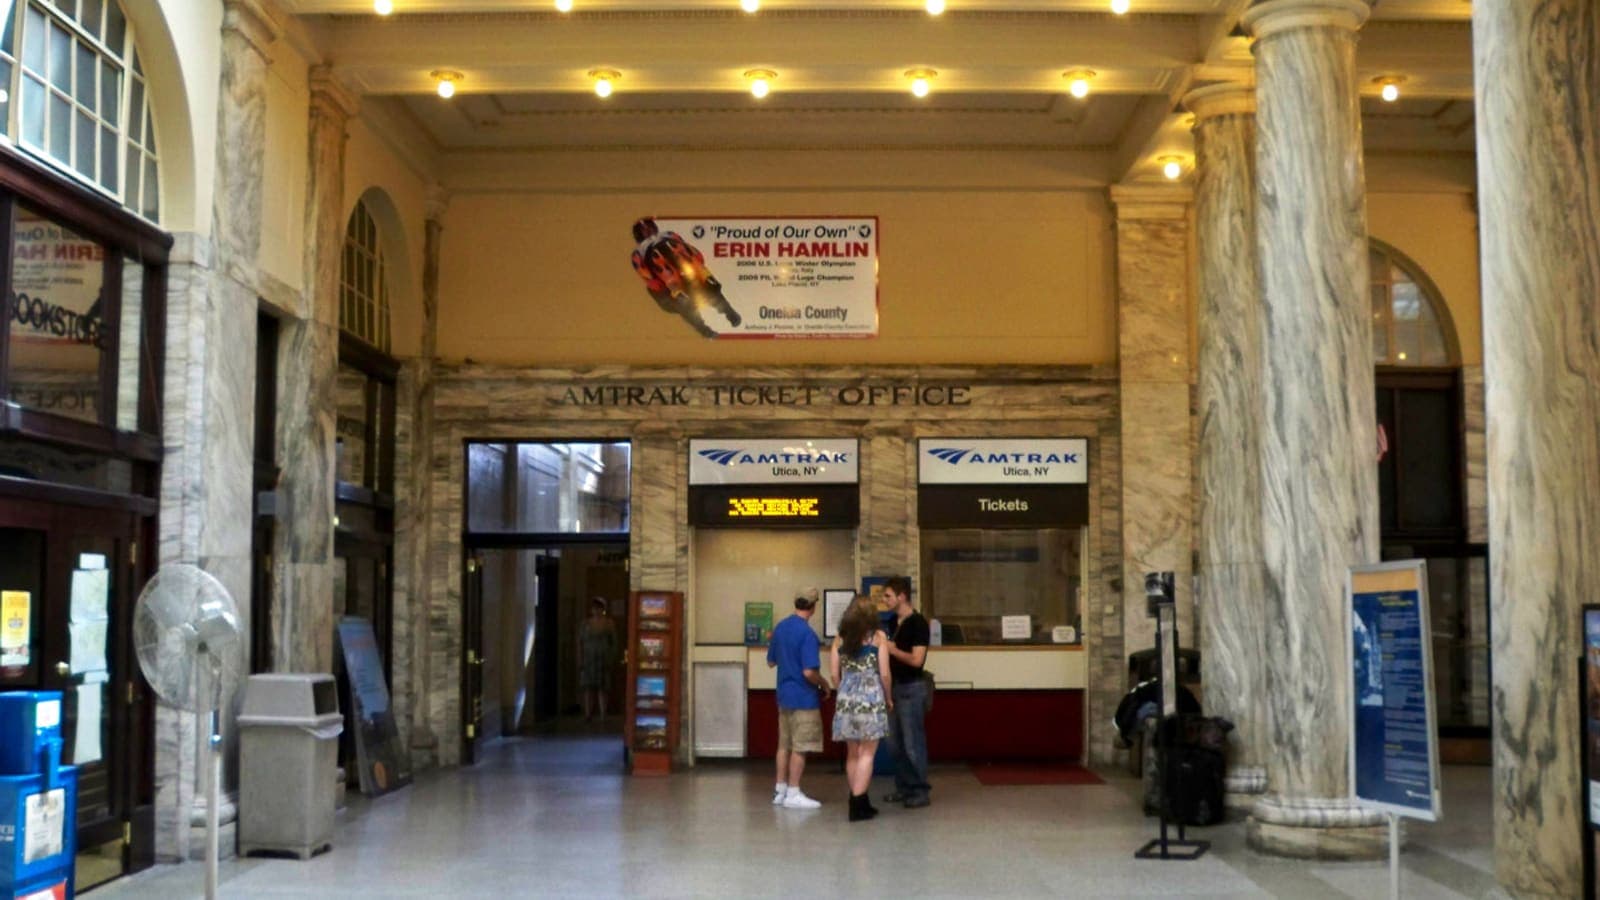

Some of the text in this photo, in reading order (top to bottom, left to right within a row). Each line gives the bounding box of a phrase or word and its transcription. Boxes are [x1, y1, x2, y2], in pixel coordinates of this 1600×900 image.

[710, 225, 855, 239] "Proud of Our Own"
[713, 242, 869, 258] ERIN HAMLIN
[821, 260, 856, 268] Olympian
[817, 274, 855, 282] Champion
[805, 305, 848, 322] County
[561, 385, 972, 407] AMTRAK TICKET OFFICE
[739, 453, 848, 464] AMTRAK
[969, 453, 1077, 464] AMTRAK
[772, 466, 819, 477] Utica, NY
[1003, 466, 1050, 477] Utica, NY
[978, 498, 1029, 512] Tickets
